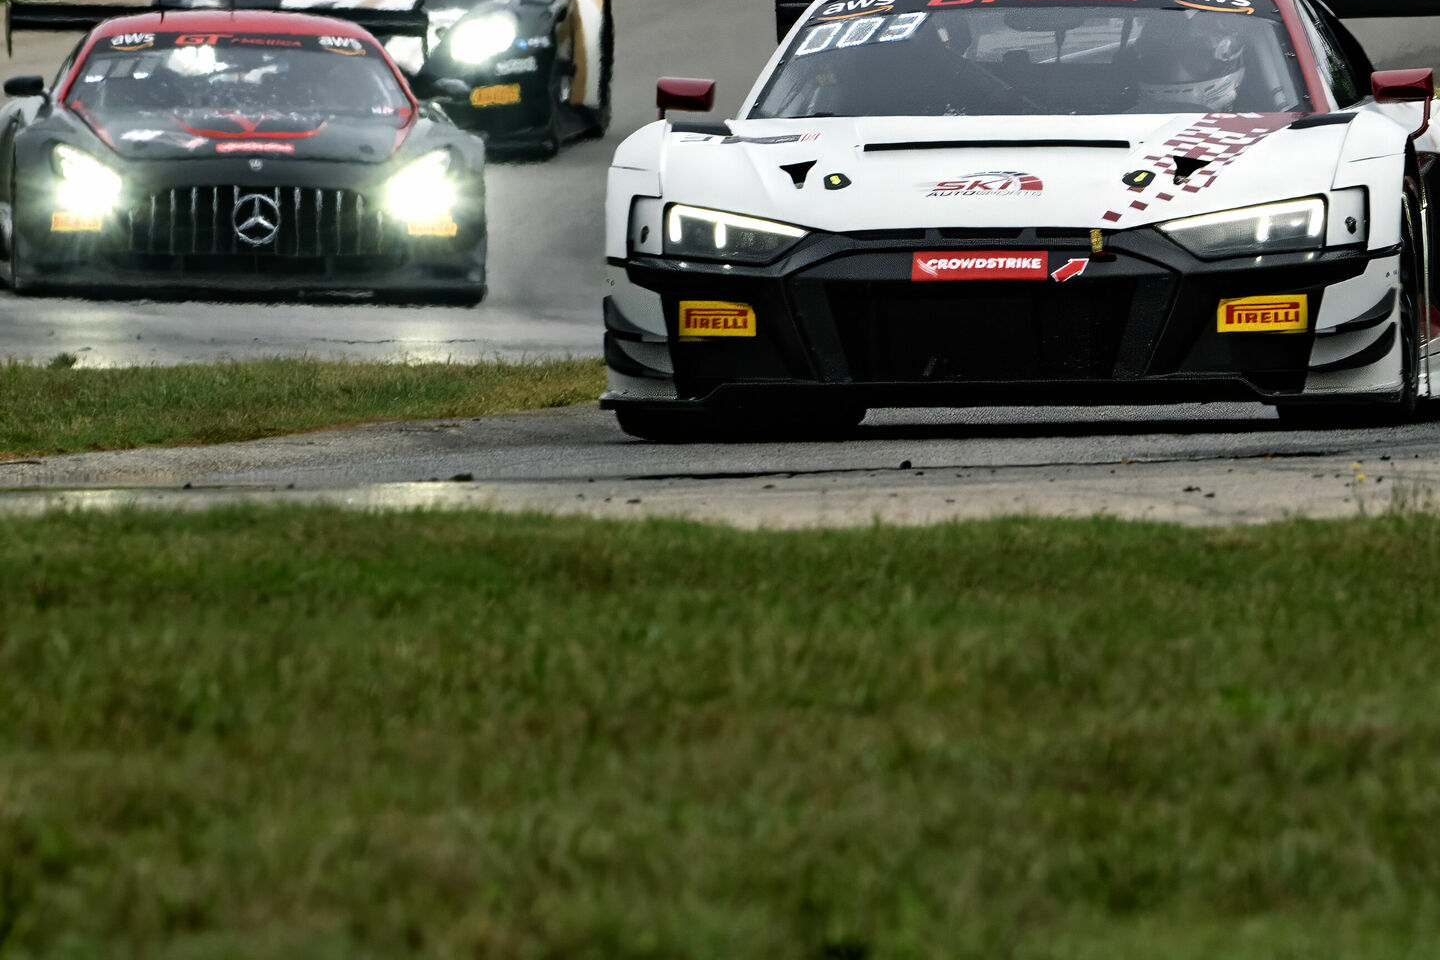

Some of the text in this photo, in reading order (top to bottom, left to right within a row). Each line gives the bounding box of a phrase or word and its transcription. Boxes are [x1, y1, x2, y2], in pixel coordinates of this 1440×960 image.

[174, 34, 233, 46] GT
[795, 11, 929, 56] 003
[932, 178, 1014, 191] SKI
[925, 257, 1042, 270] CROWDSTRIKE
[685, 308, 748, 329] PIRELLI
[1225, 302, 1300, 324] PIRELLI
